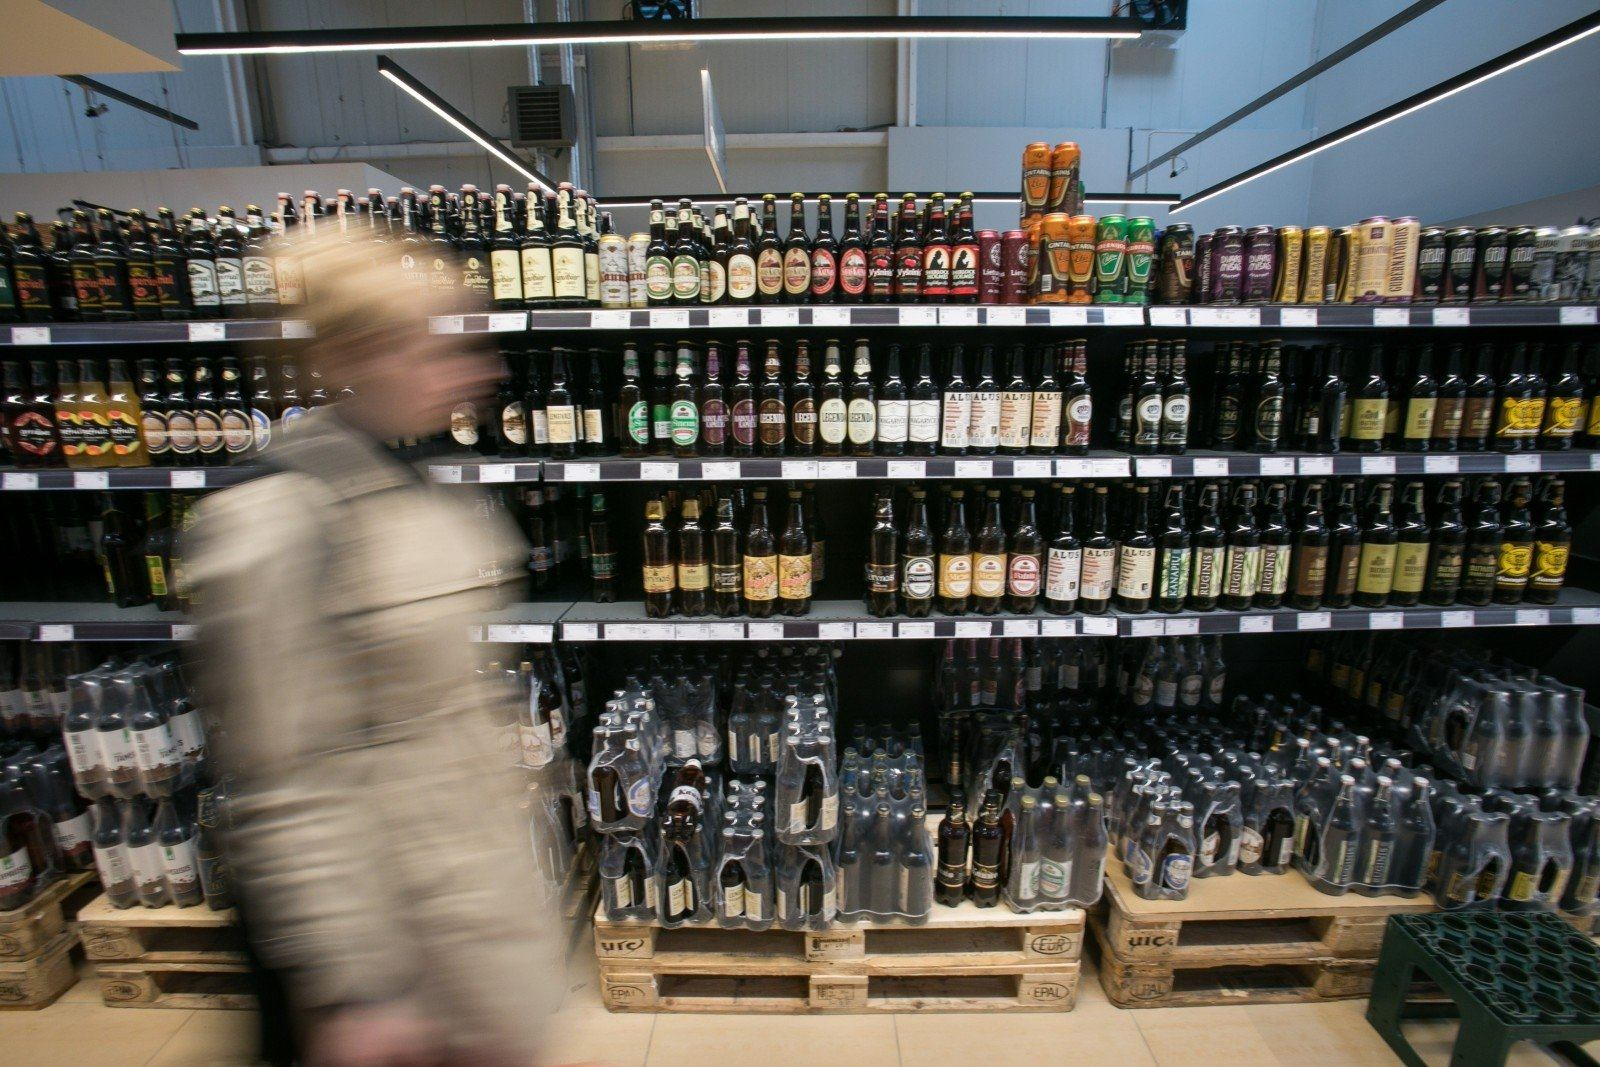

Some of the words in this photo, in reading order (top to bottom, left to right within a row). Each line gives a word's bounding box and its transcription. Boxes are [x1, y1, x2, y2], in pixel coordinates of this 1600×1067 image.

[974, 394, 1000, 402] ALUS
[1004, 394, 1031, 402] ALUS
[1038, 394, 1062, 402] ALUS
[1053, 550, 1080, 559] ALUS
[1087, 550, 1114, 558] ALUS
[1124, 550, 1152, 559] ALUS
